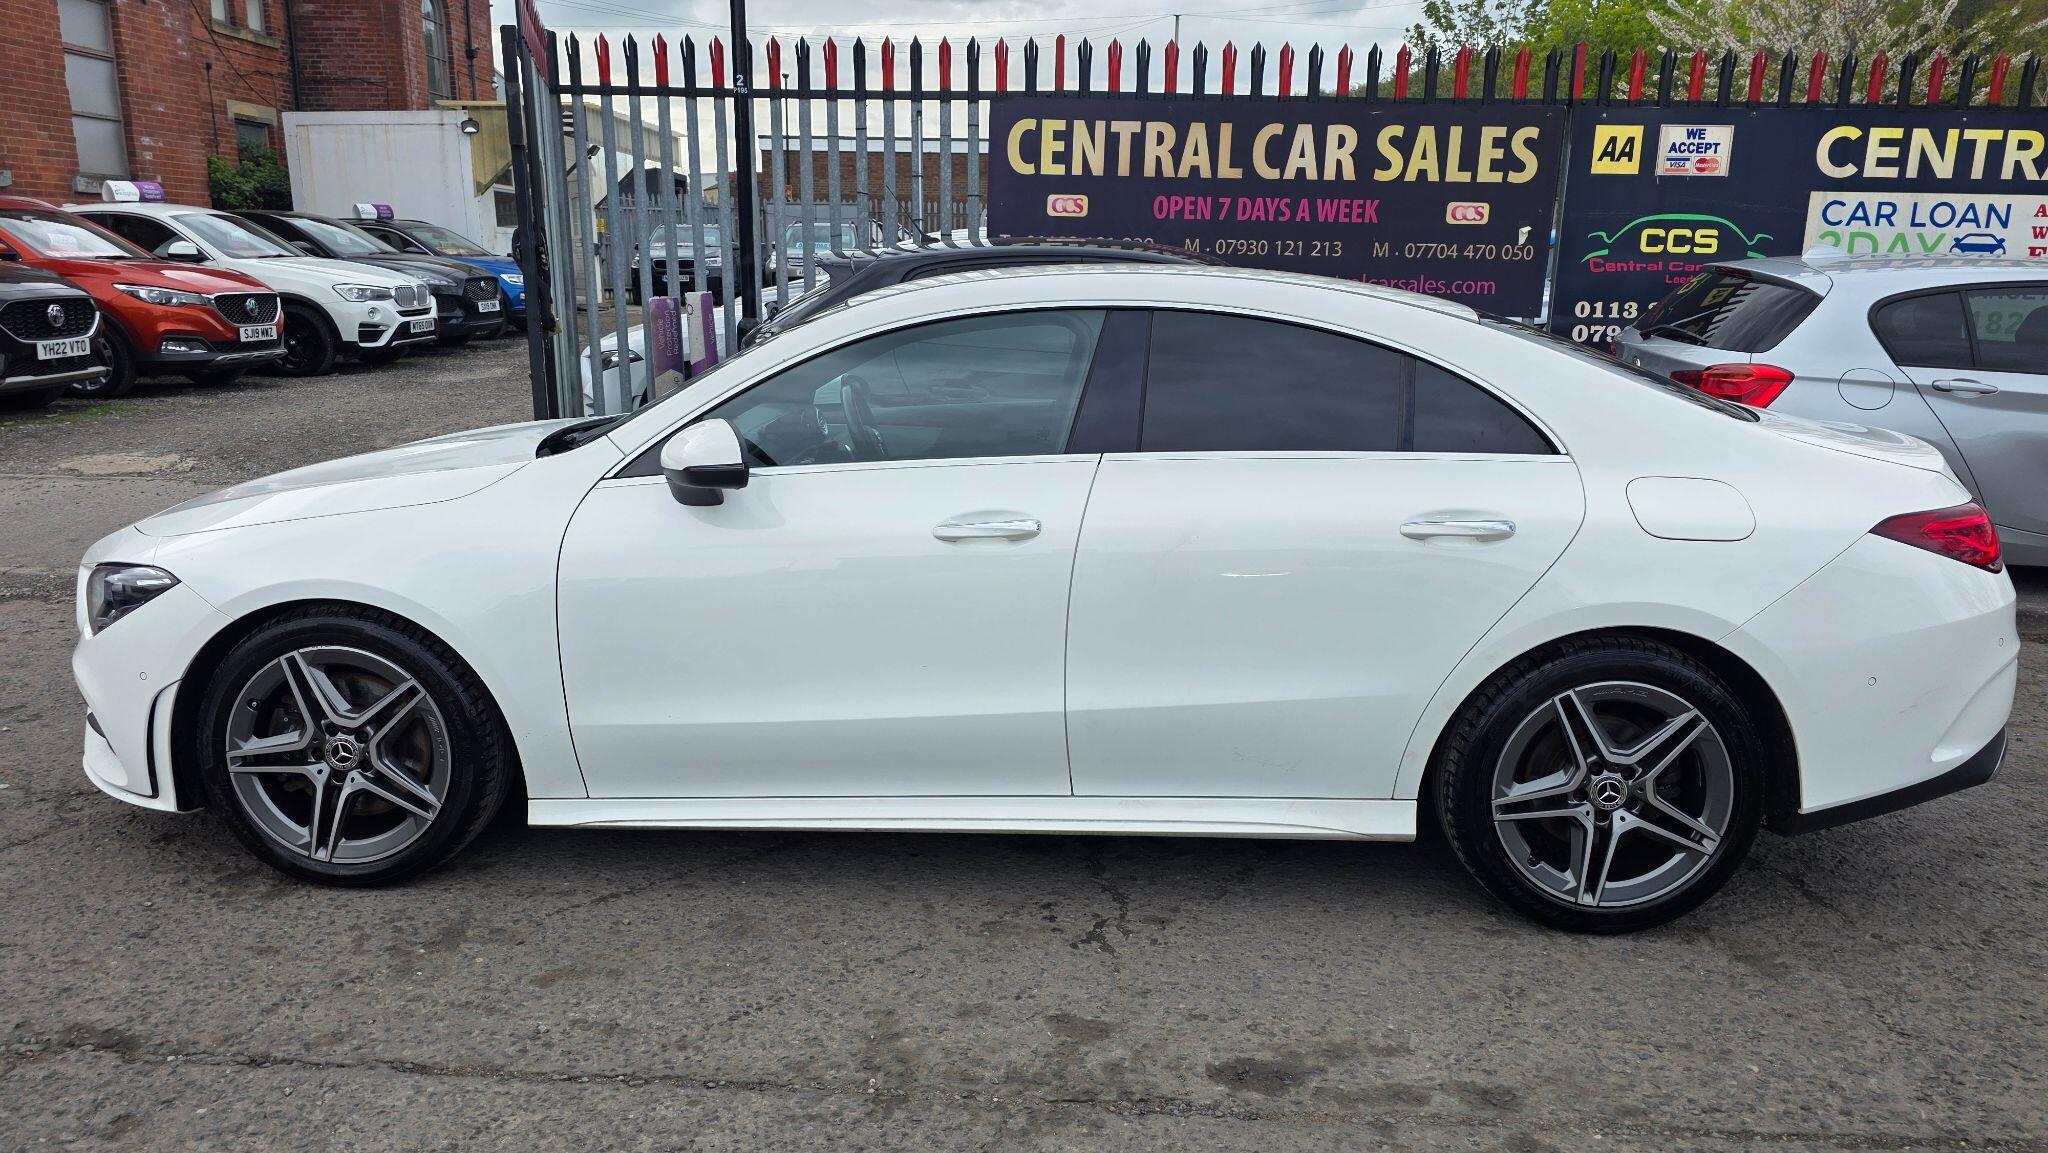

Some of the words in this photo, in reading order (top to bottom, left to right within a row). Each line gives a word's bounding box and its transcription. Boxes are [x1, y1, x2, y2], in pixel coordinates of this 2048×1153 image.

[735, 74, 744, 86] 2
[1686, 128, 1707, 140] WE
[1007, 118, 1243, 179] CENTRAL
[1252, 122, 1358, 181] CAR
[1373, 124, 1540, 184] SALES
[1597, 136, 1636, 163] AA
[1667, 142, 1721, 154] ACCEPT
[1816, 125, 2048, 181] CENTR
[1153, 195, 1211, 221] OPEN
[1218, 197, 1231, 221] 7
[1236, 196, 1292, 222] DAYS
[1295, 198, 1311, 223] A
[1317, 198, 1380, 224] WEEK
[1821, 199, 1898, 228] CAR
[1909, 201, 2012, 230] LOAN
[1215, 239, 1269, 256] 07930
[1275, 240, 1303, 256] 121
[1310, 240, 1342, 257] 213
[1640, 228, 1719, 254] CCS
[1404, 242, 1459, 260] 07704
[1463, 243, 1497, 261] 470
[1501, 244, 1534, 262] 050
[1588, 257, 1663, 273] Central
[1668, 261, 1704, 272] Car
[1574, 300, 1639, 319] 0113
[1571, 324, 1622, 343] 079
[42, 342, 68, 357] YH22
[69, 340, 87, 354] VTO
